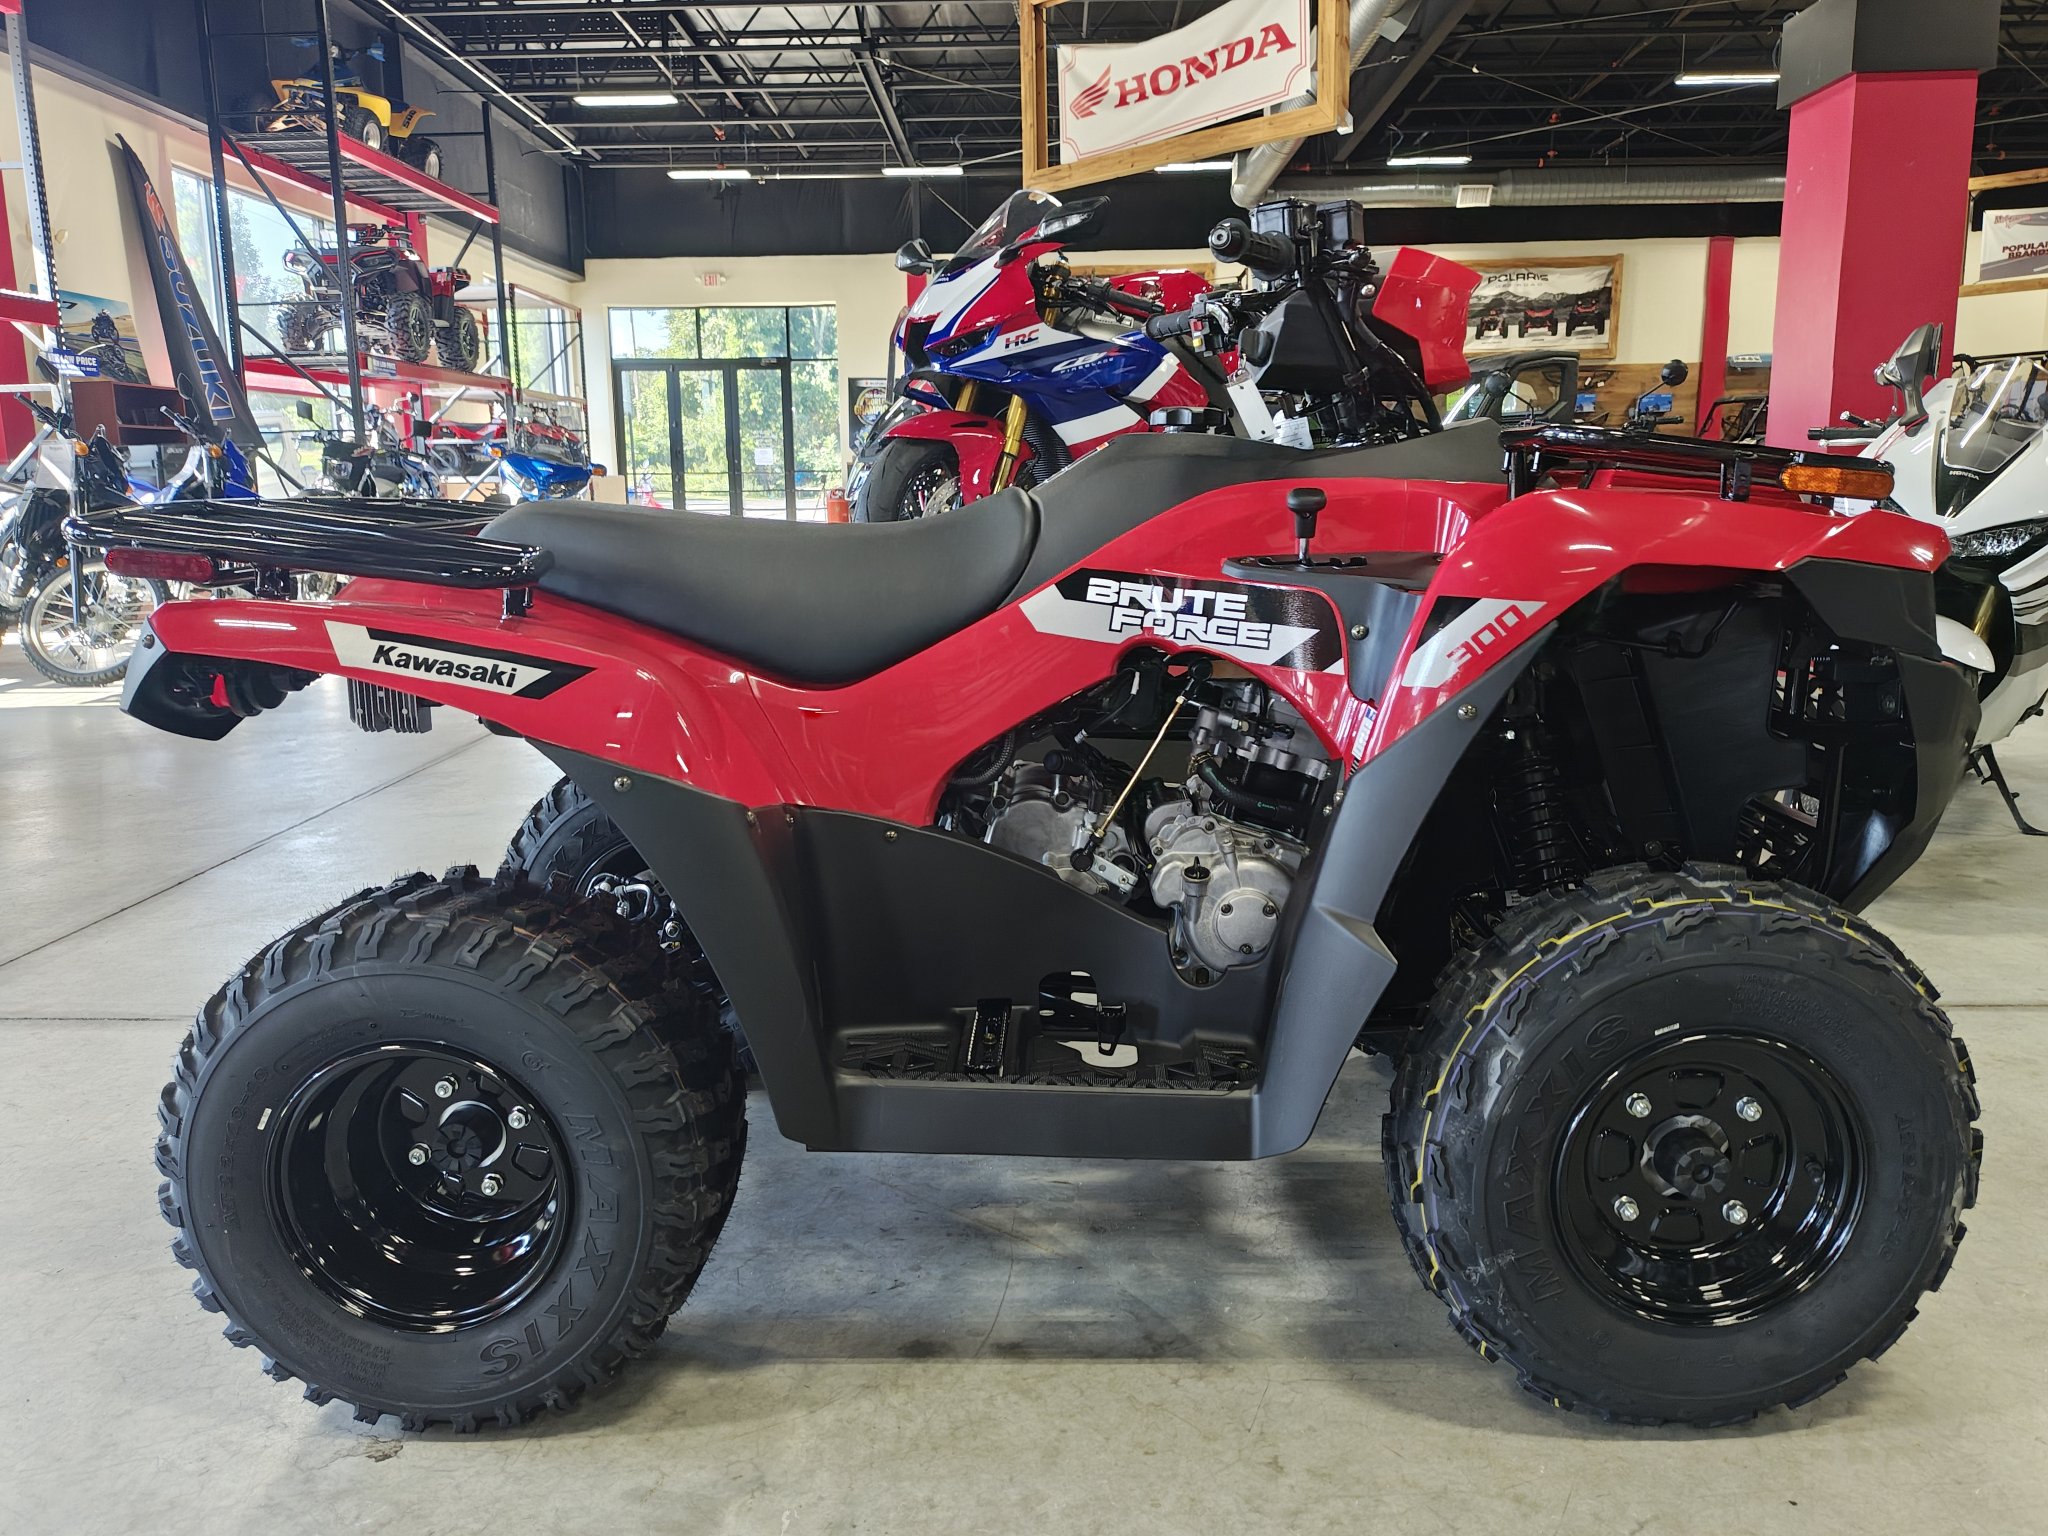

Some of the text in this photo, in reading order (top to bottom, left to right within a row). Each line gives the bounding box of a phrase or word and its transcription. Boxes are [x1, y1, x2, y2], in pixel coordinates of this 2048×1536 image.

[1113, 22, 1297, 109] HONDA
[1488, 271, 1549, 284] POLARIS
[159, 234, 236, 421] SUZUKI
[1004, 328, 1040, 350] HRC
[75, 356, 98, 366] PRICE
[1060, 356, 1114, 374] FIREBLADE
[1949, 470, 1980, 480] HONDA
[1086, 577, 1249, 620] BRUTE
[1108, 605, 1271, 651] FORCE
[1446, 604, 1529, 668] 300
[372, 644, 518, 688] Kawasaki
[1503, 1014, 1630, 1303] MAXXIS
[479, 1113, 620, 1376] MAXXIS
